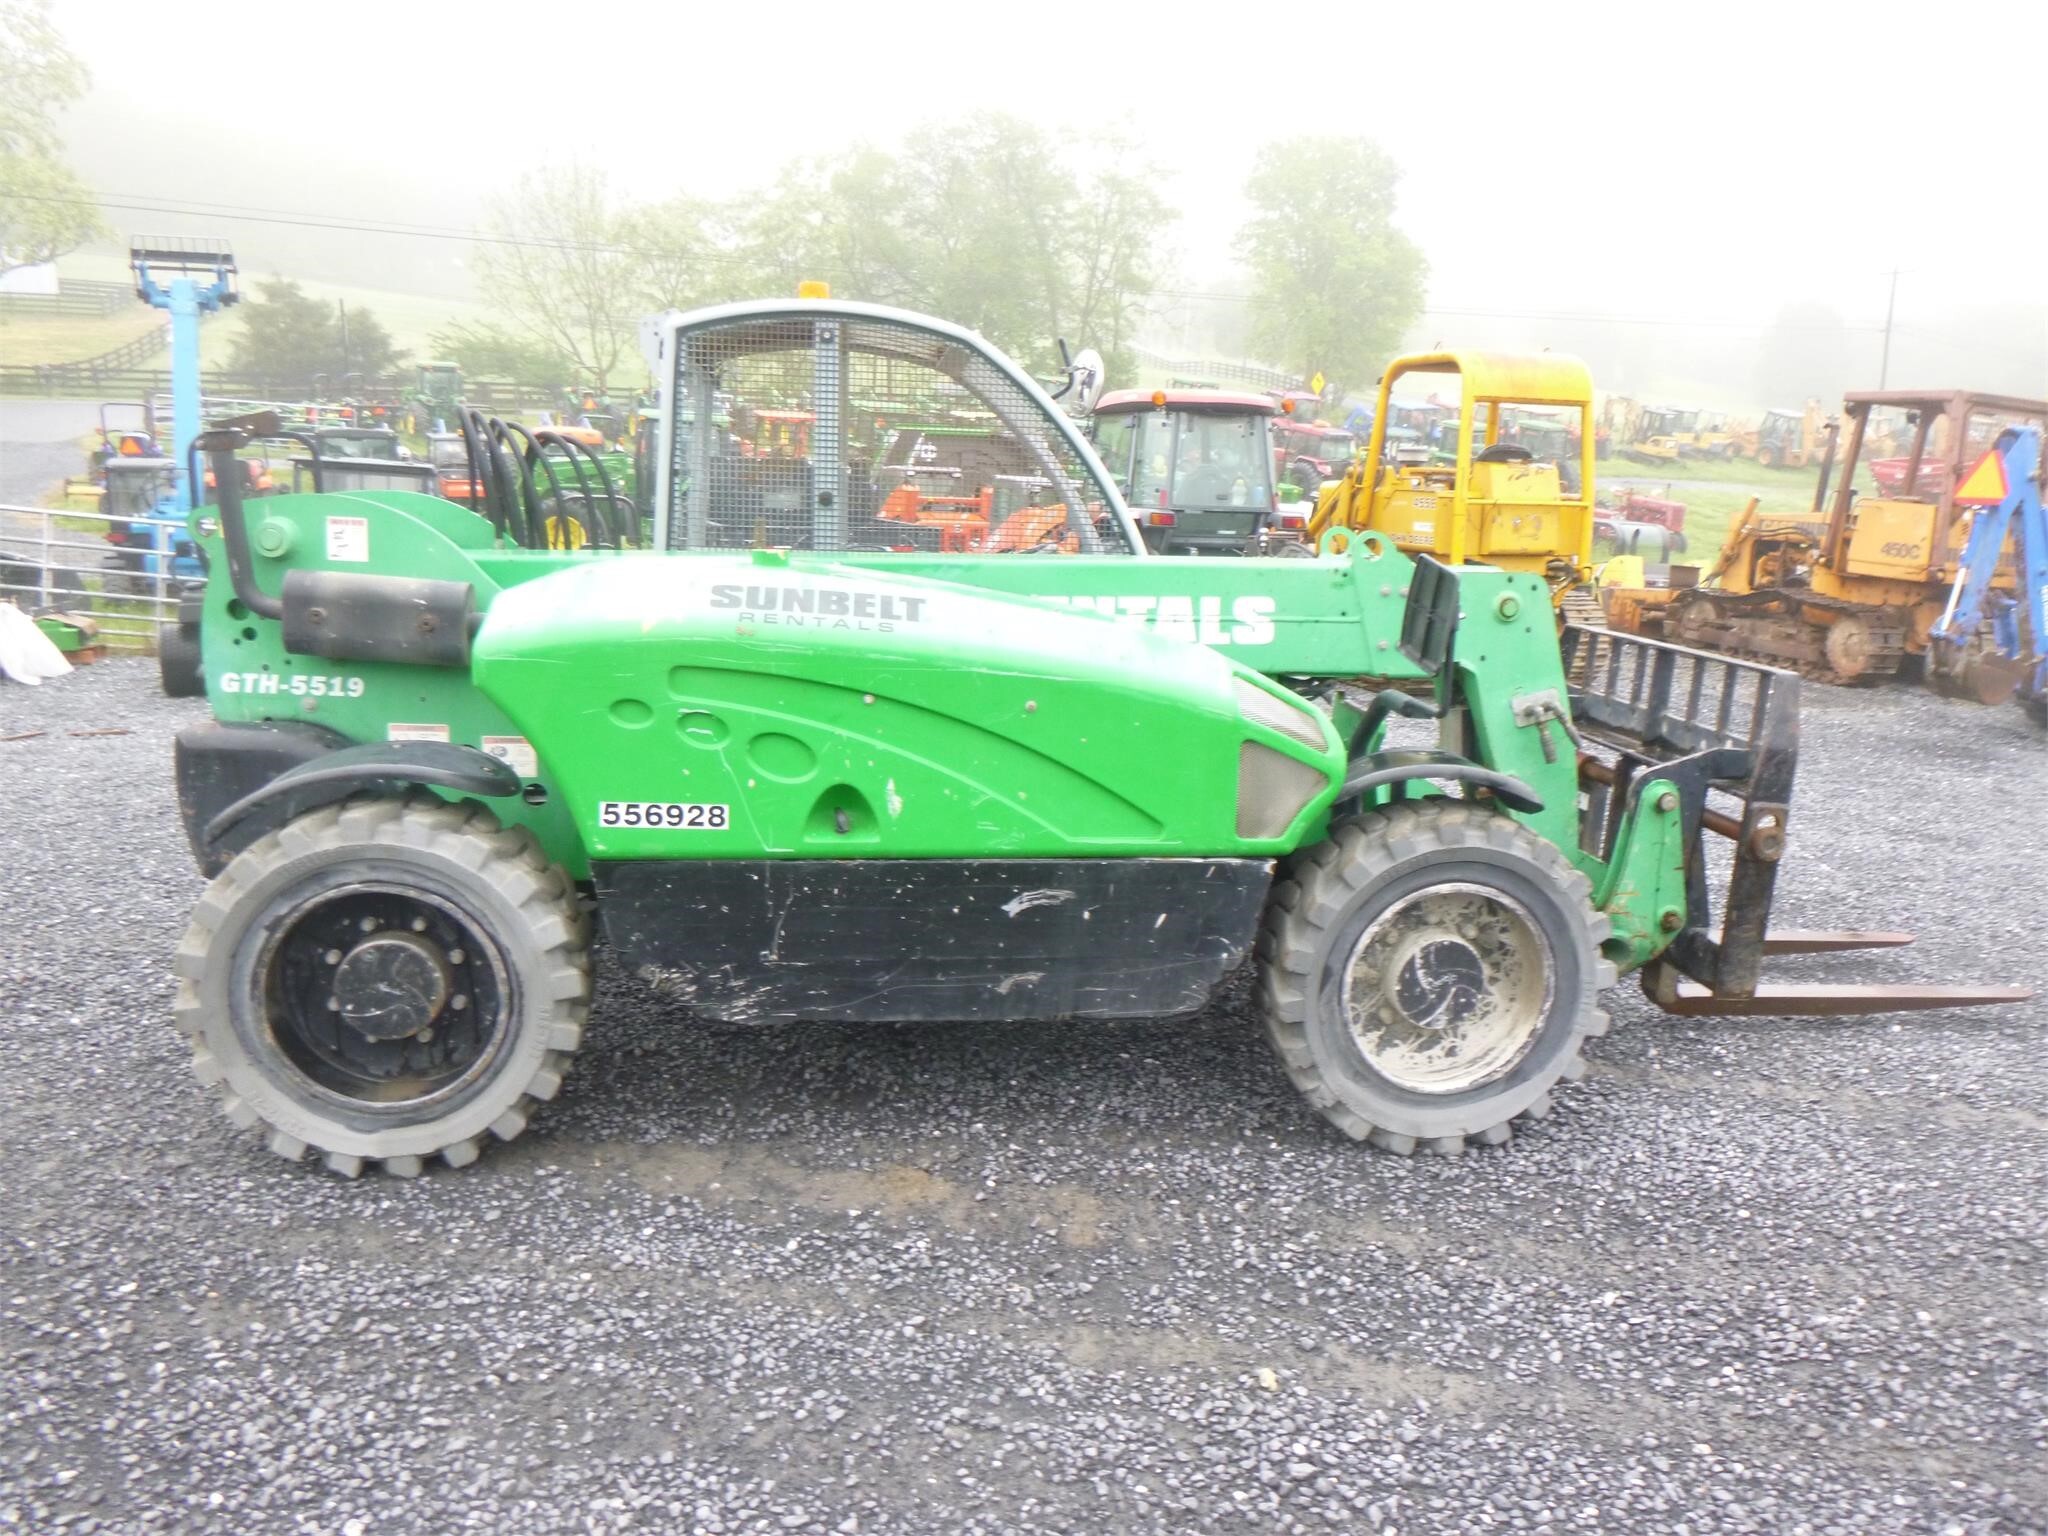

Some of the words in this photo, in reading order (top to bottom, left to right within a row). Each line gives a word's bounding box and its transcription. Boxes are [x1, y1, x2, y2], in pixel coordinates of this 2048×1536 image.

[1880, 542, 1921, 560] 450C
[710, 585, 927, 622] SUNBELT
[738, 612, 894, 633] RENTALS
[1032, 595, 1276, 645] TALS
[220, 672, 365, 698] GTH-5519
[602, 803, 726, 827] 556928
